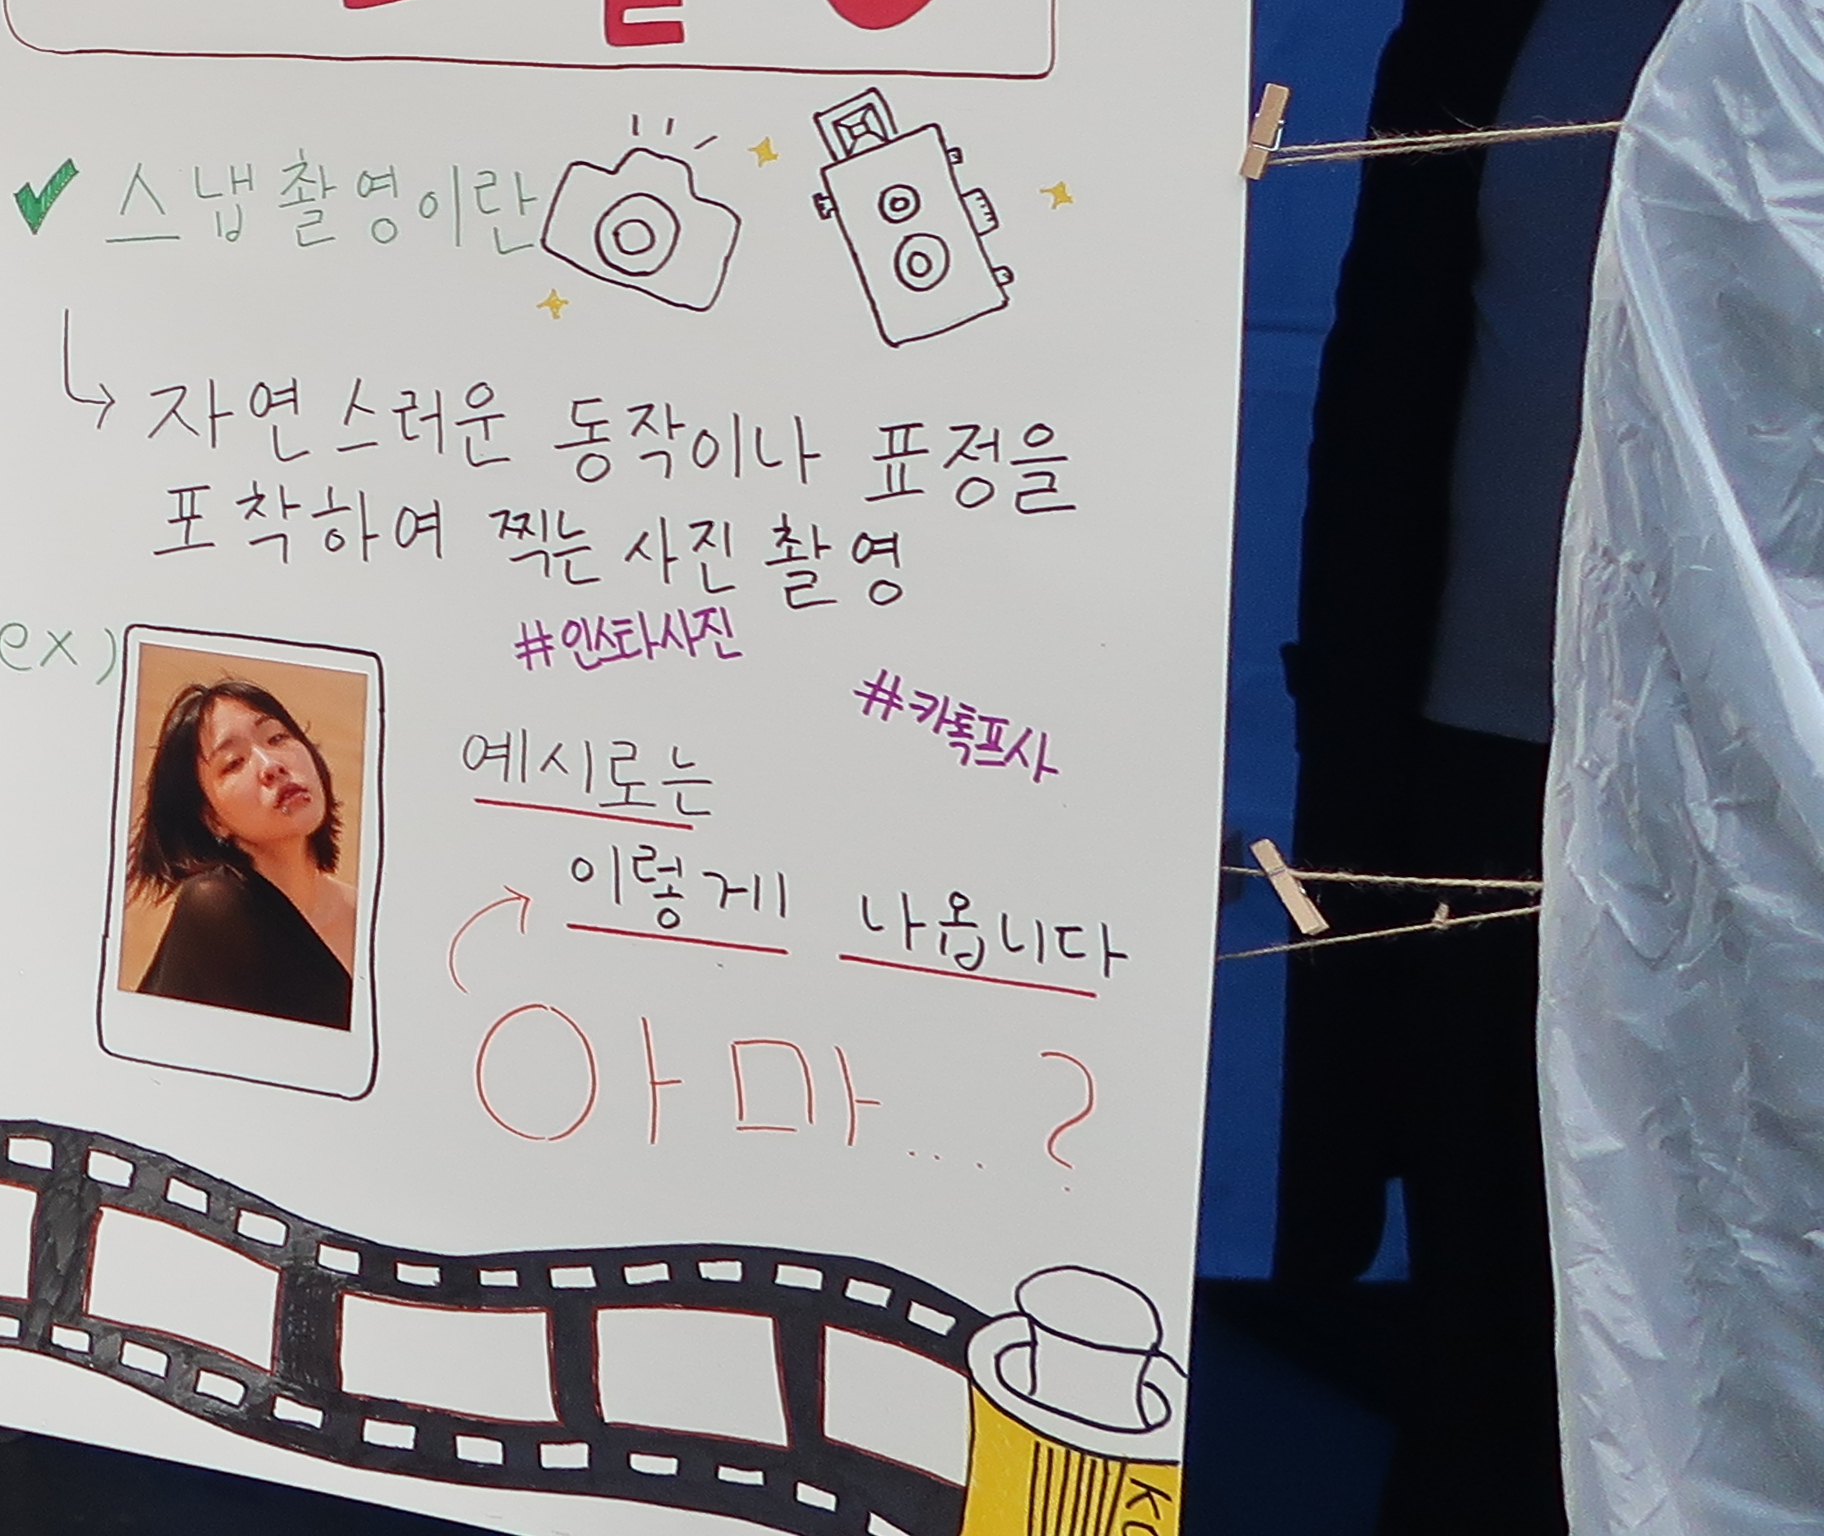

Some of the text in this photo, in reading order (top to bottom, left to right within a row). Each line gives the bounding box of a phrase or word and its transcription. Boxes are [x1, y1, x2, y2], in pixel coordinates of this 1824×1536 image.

[553, 398, 823, 484] 동작이나
[864, 420, 1078, 514] 표정을
[153, 481, 447, 562] 포착하여
[489, 507, 600, 587] 찍는
[623, 514, 737, 595] 사진
[514, 606, 743, 671] #인스타사진
[462, 728, 713, 817] 예시로는
[852, 668, 1060, 783] #카톡프사
[570, 843, 1128, 972] 이렇게 나옵니다
